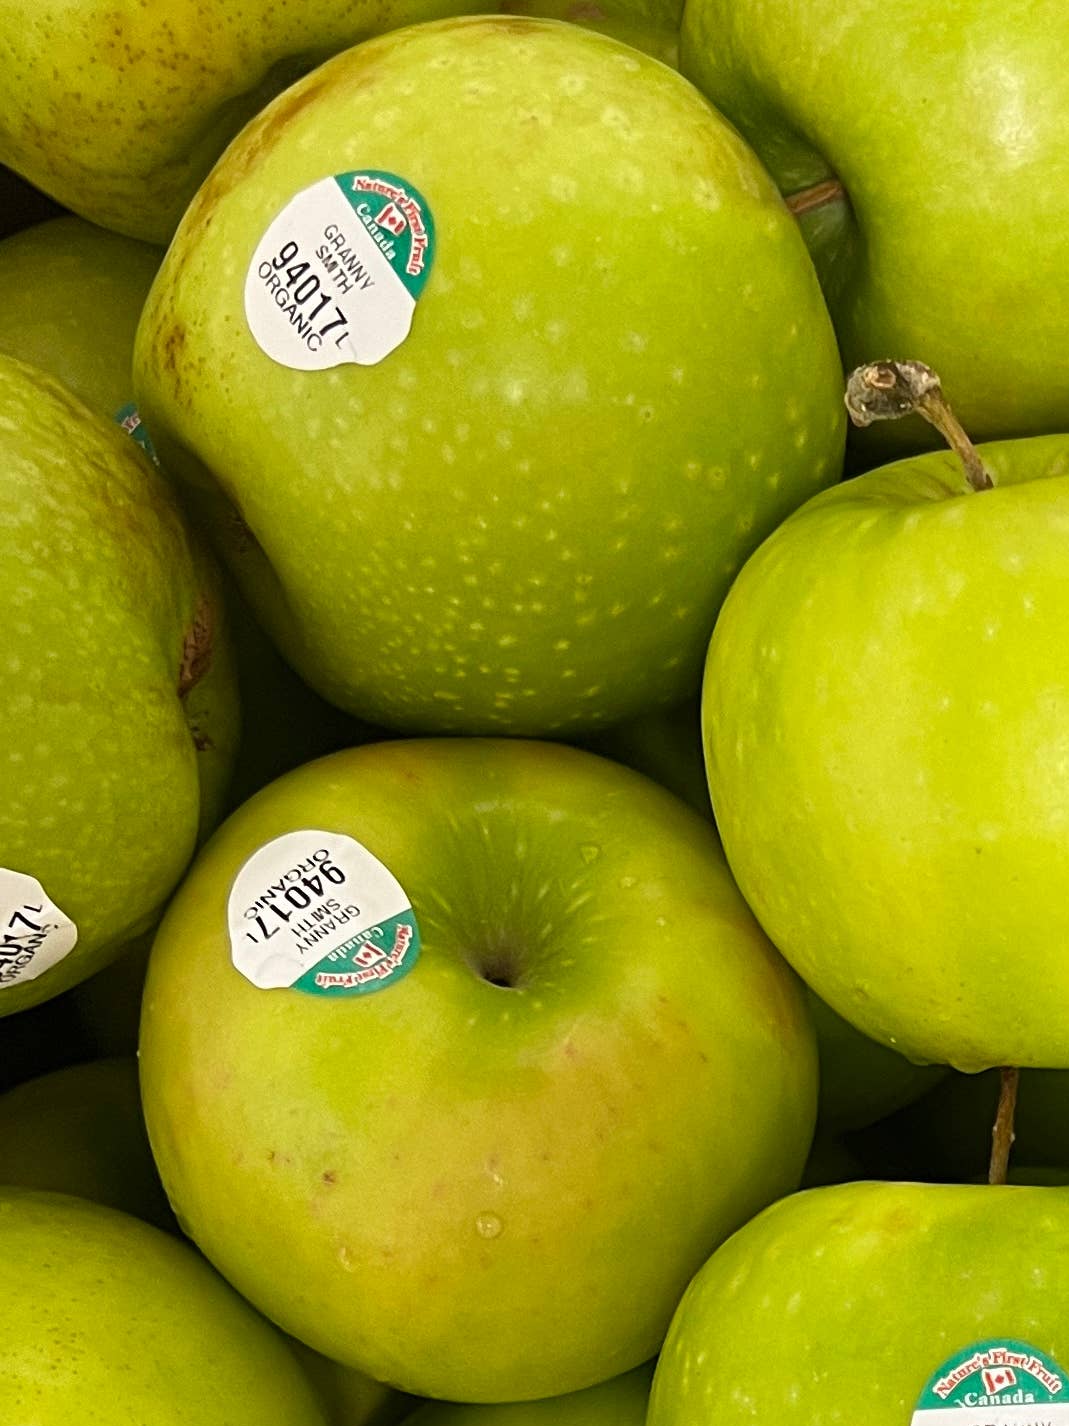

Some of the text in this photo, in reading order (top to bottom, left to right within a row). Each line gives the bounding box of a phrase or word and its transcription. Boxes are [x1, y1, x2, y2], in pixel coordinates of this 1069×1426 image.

[356, 203, 397, 260] Canada
[315, 245, 354, 294] SMITH
[324, 224, 375, 290] GRANNY
[258, 261, 323, 351] ORGANIC
[244, 849, 329, 920] ORGANIC
[291, 898, 341, 937] SMITH
[296, 905, 360, 954] GRANNY
[327, 926, 384, 962] Canada
[932, 1347, 1063, 1399] Nature's First Fruit
[964, 1389, 1034, 1407] Canada
